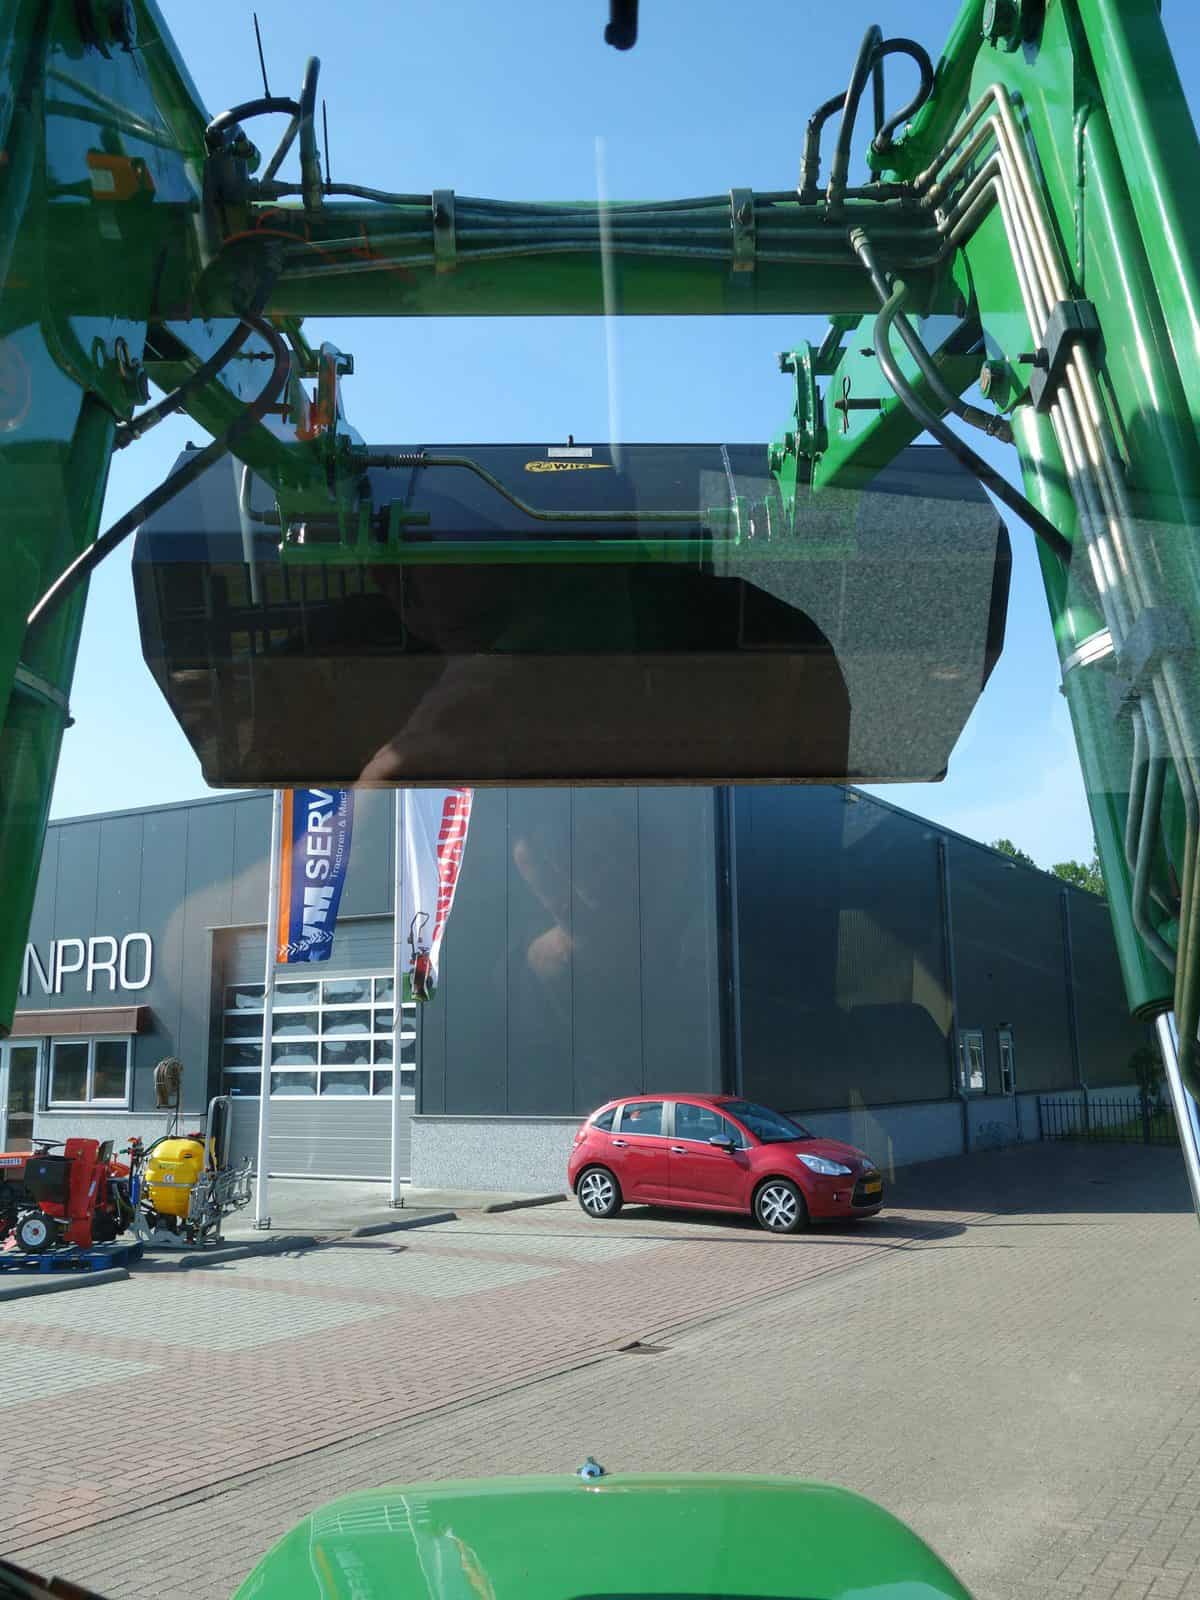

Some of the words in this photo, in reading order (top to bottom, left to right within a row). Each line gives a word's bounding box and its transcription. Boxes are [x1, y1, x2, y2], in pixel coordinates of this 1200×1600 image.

[305, 789, 334, 881] SERV
[329, 831, 345, 879] Tractoren
[22, 932, 152, 996] NPRO
